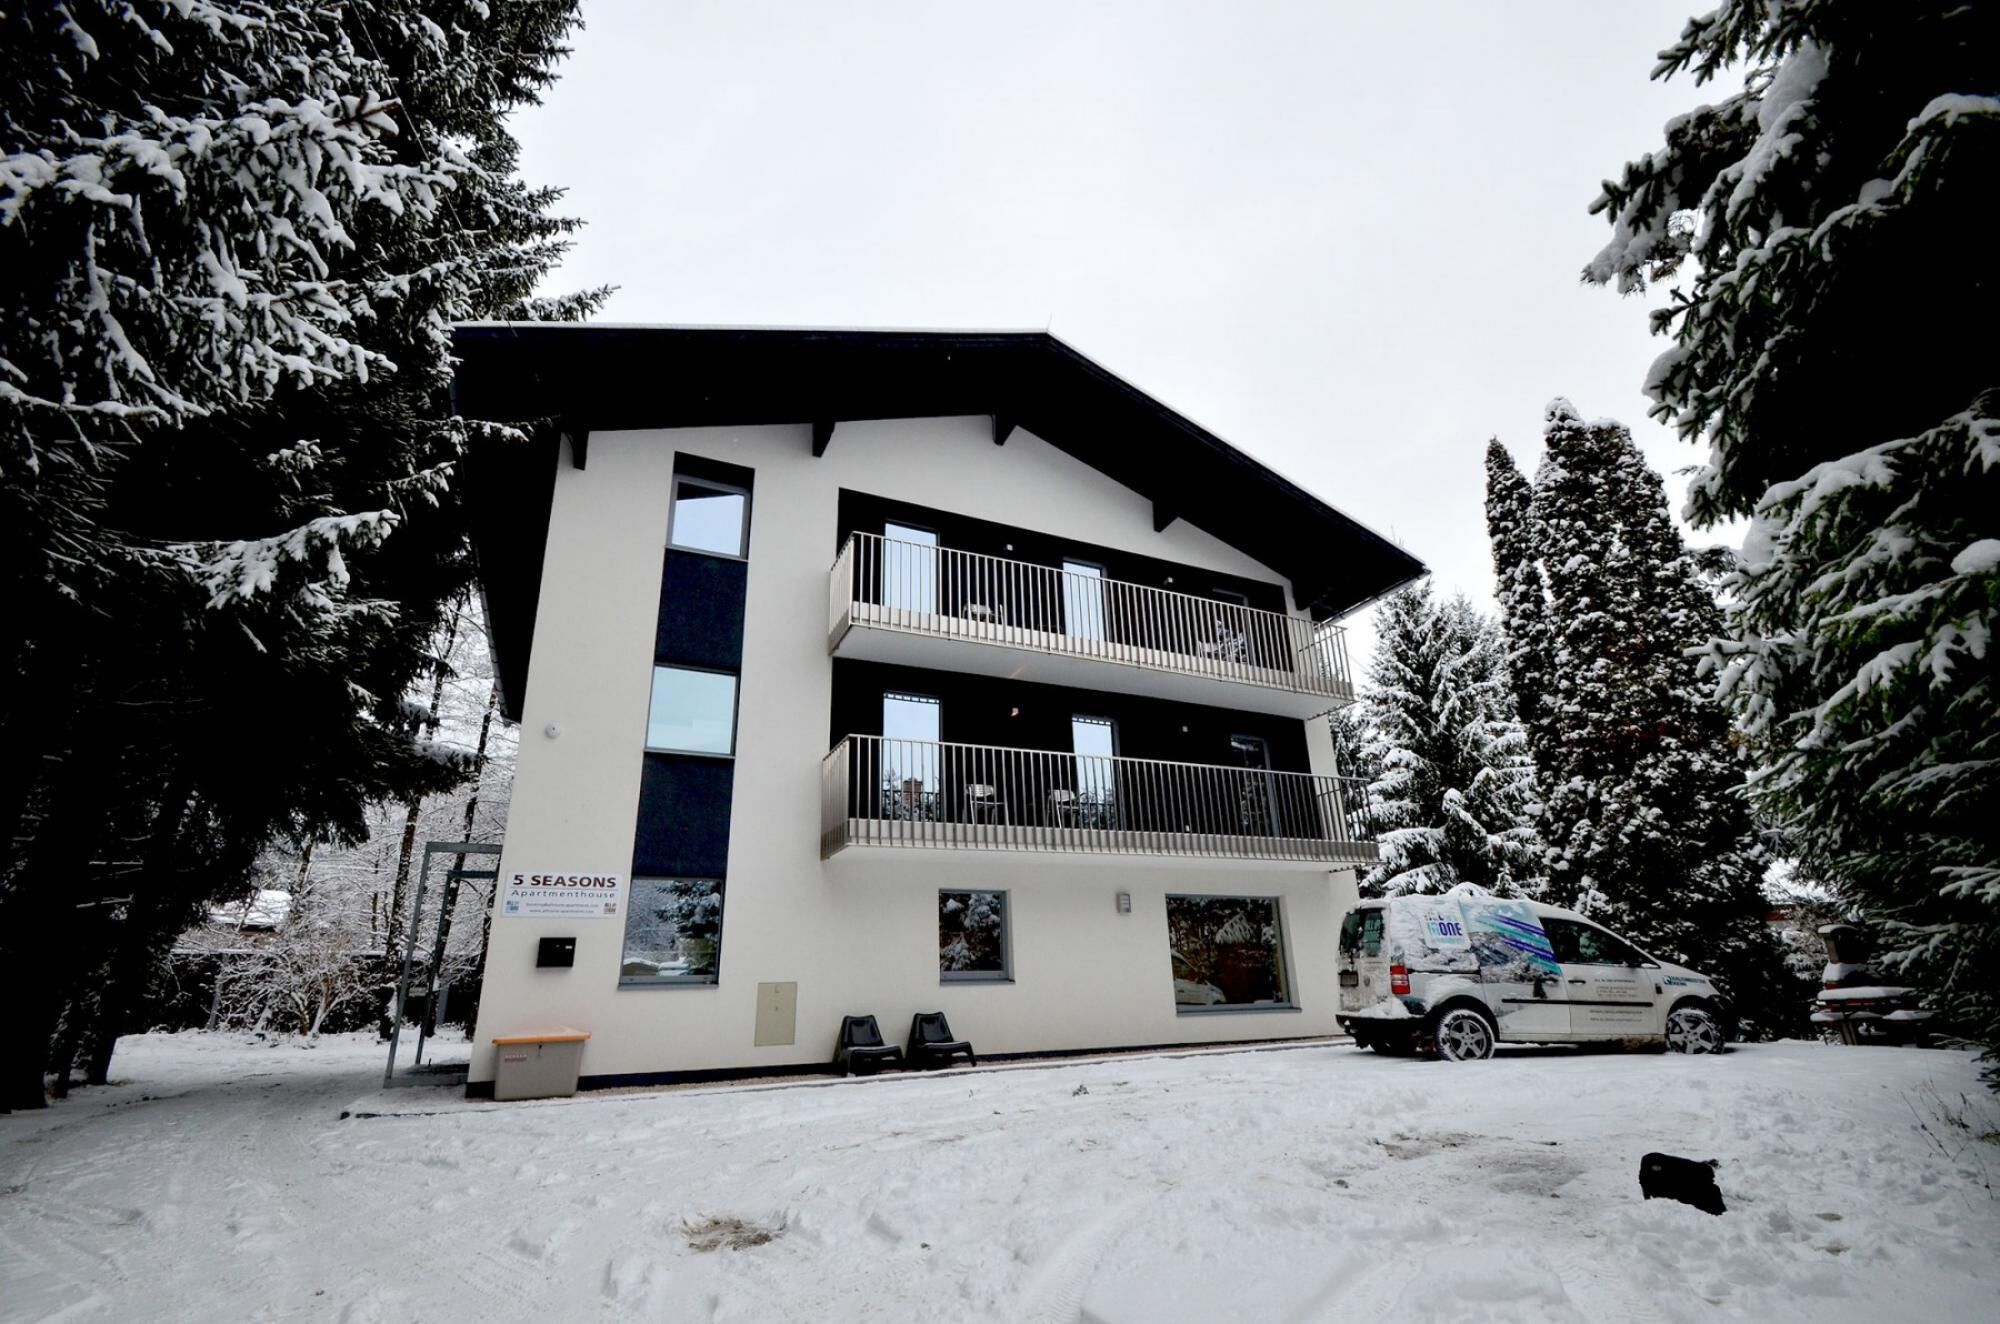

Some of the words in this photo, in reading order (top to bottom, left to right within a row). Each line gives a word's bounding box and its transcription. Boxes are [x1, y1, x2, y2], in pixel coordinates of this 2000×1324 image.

[513, 874, 524, 886] 5
[530, 875, 617, 888] SEASONS
[511, 889, 616, 898] Apartmenthouse
